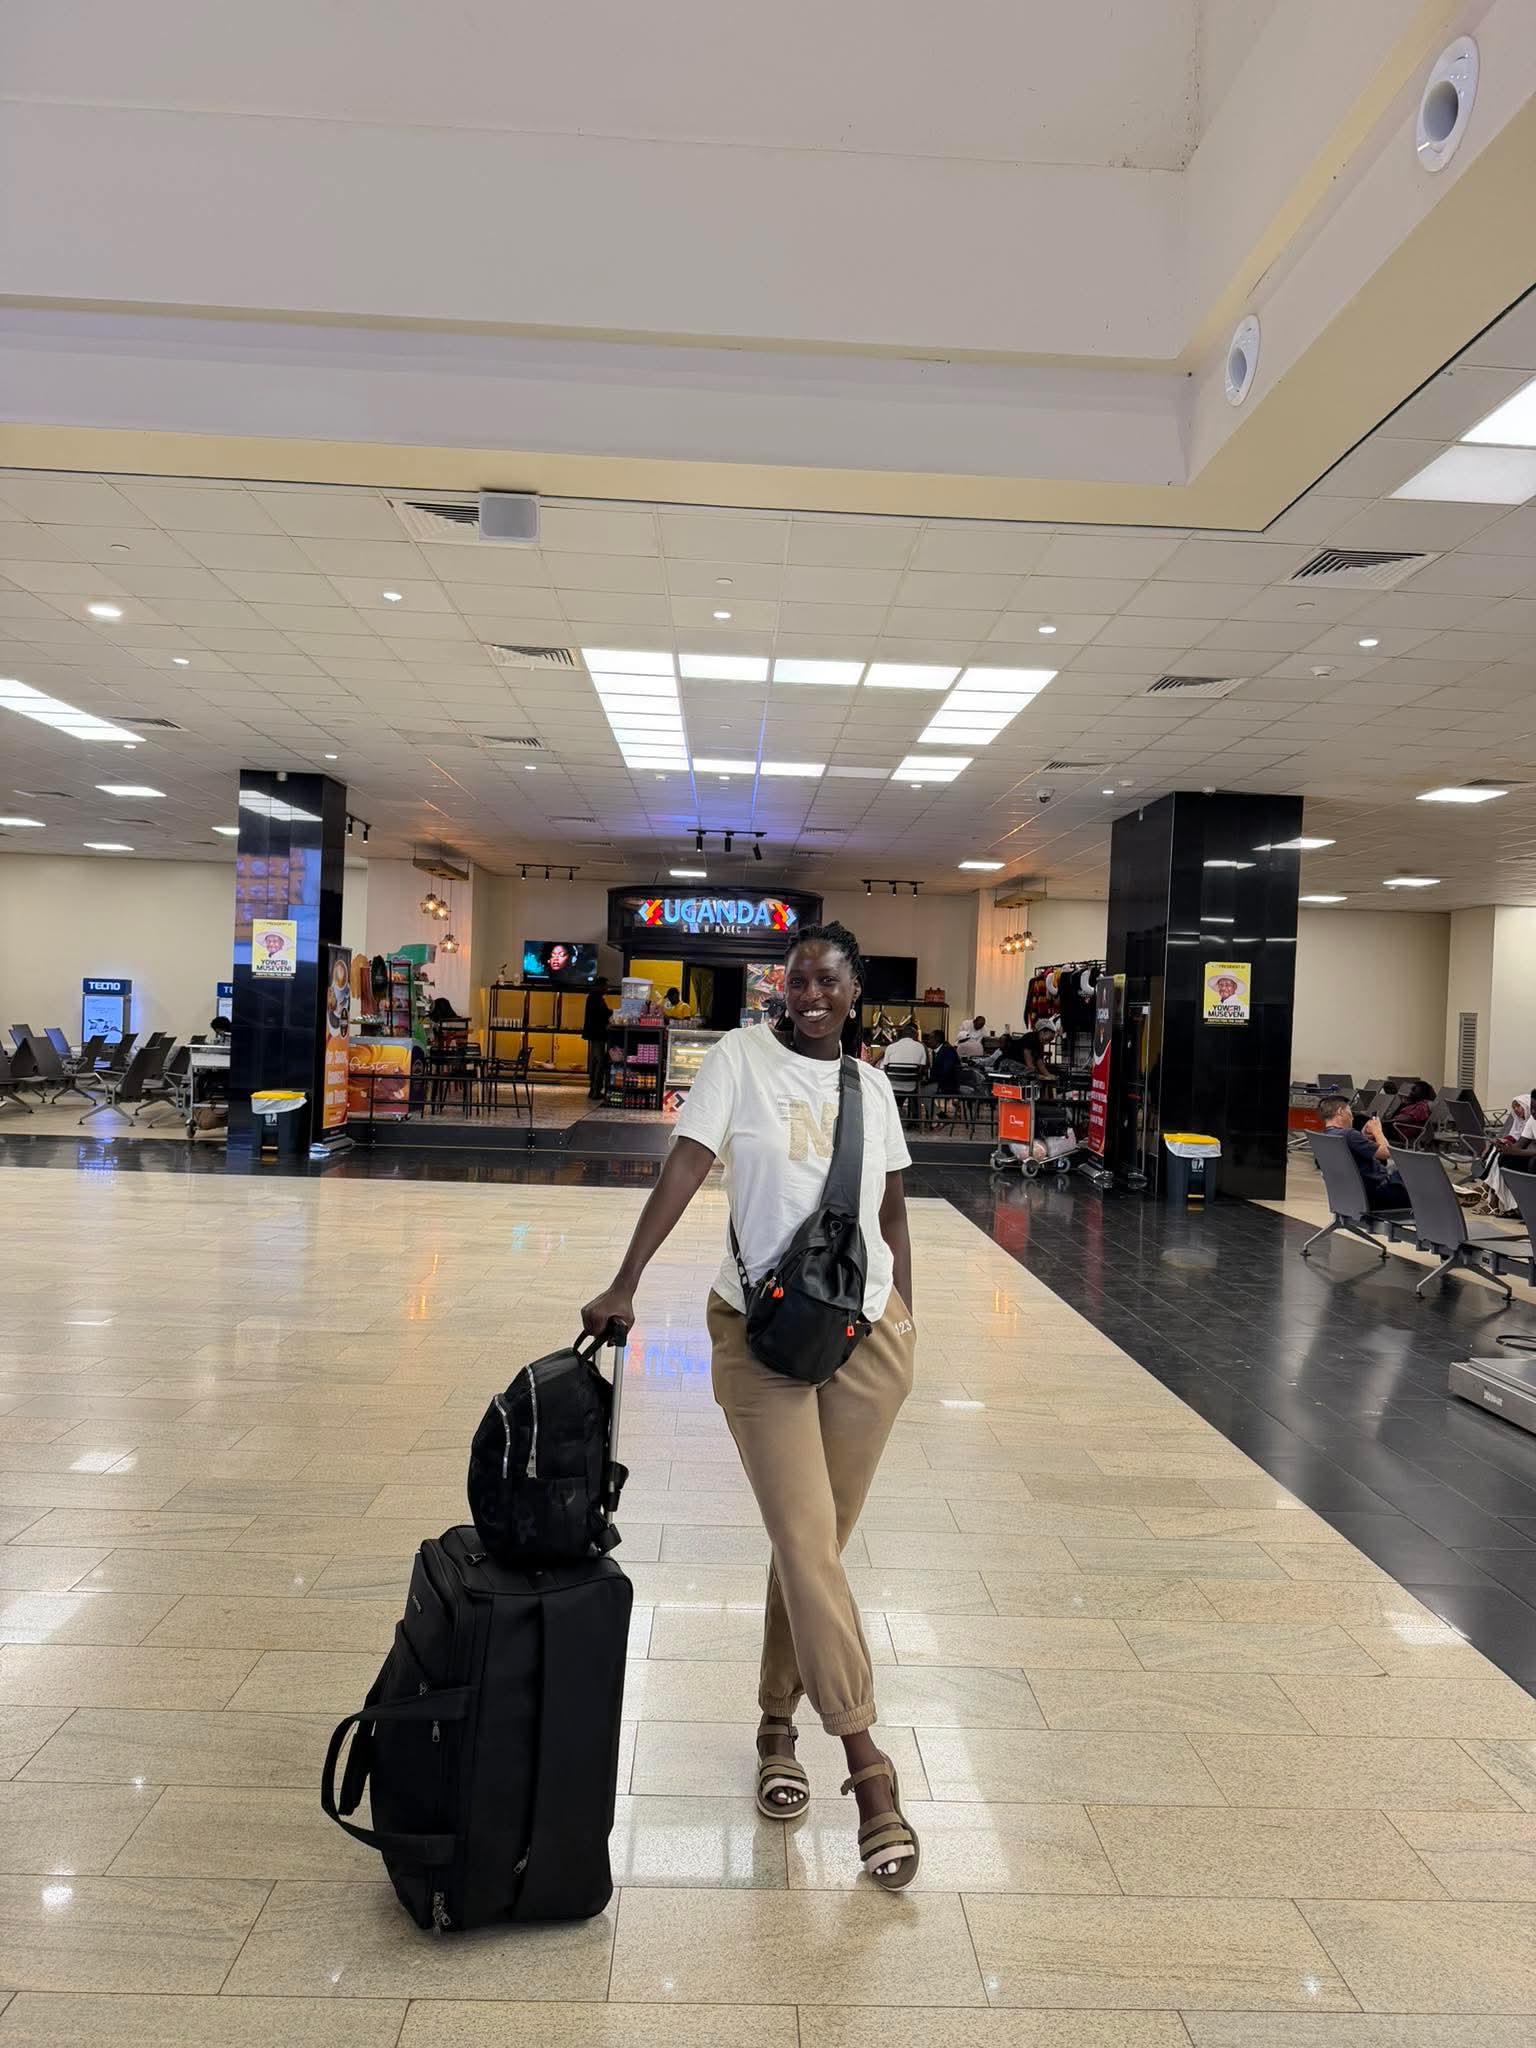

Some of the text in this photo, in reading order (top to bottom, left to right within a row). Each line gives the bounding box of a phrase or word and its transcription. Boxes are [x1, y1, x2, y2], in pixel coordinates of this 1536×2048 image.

[664, 899, 771, 926] UGANDA
[683, 924, 751, 934] CNNECT
[88, 981, 121, 991] TECNO
[1208, 1010, 1245, 1018] MUSEVENI
